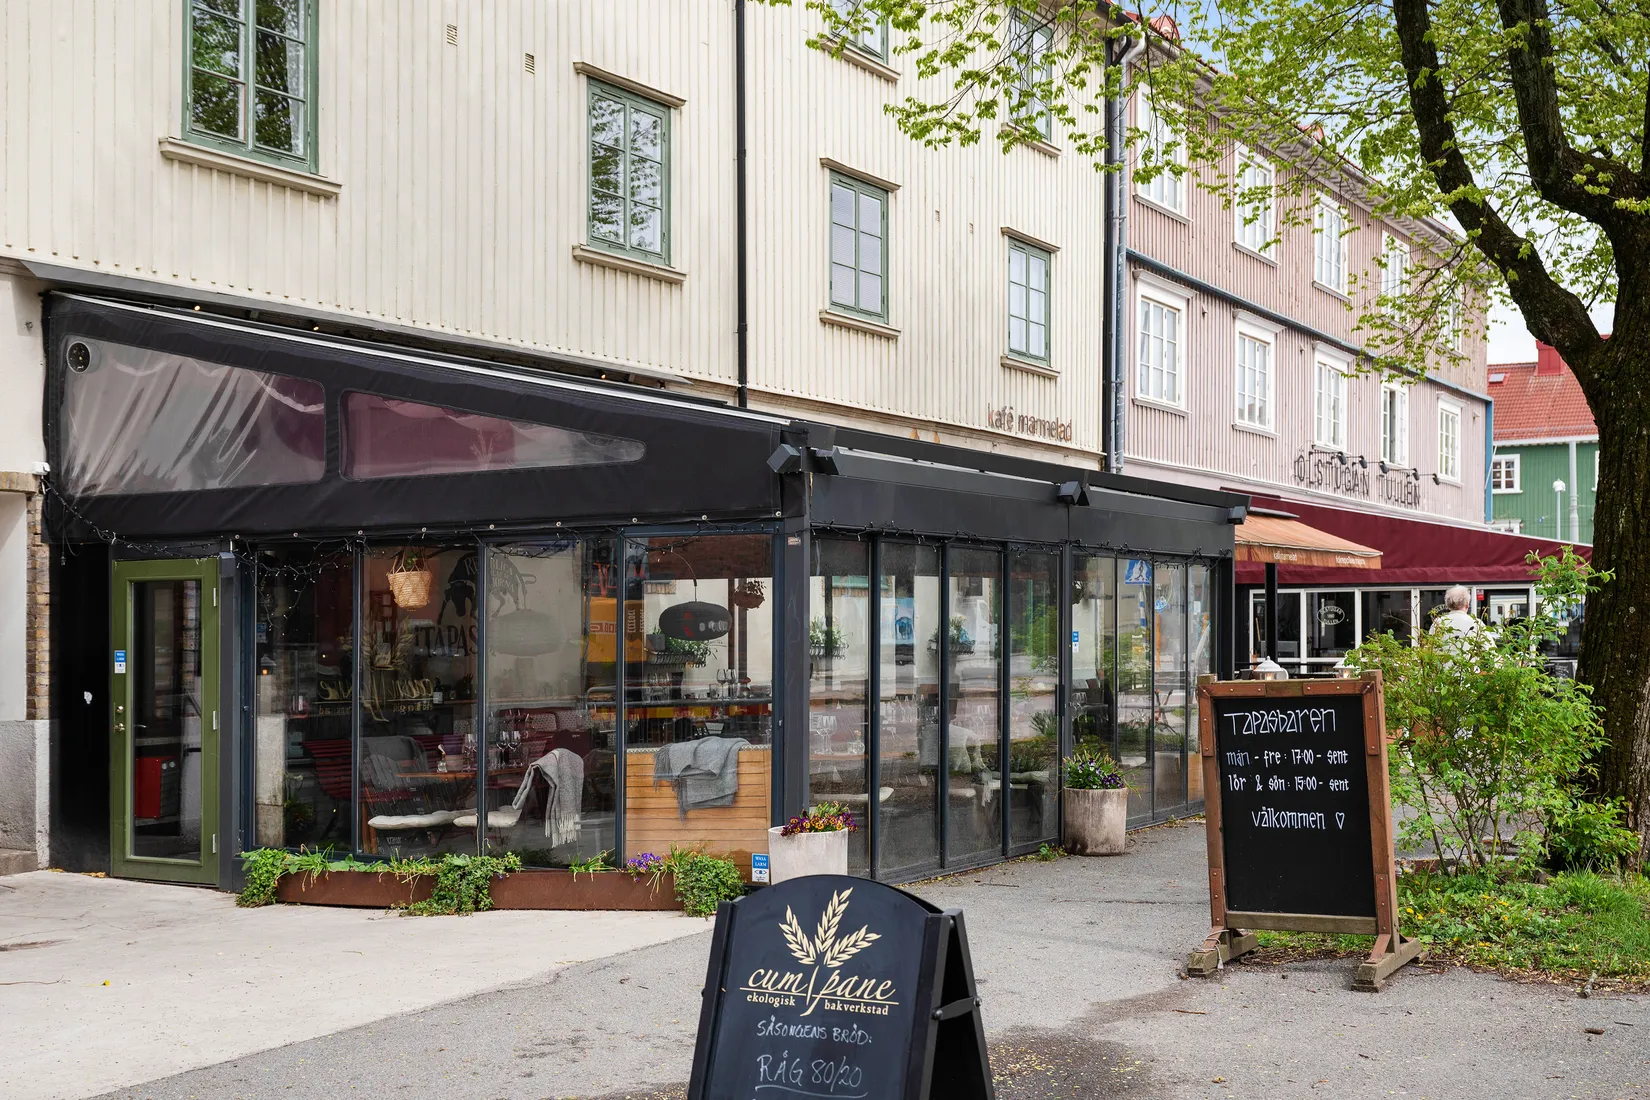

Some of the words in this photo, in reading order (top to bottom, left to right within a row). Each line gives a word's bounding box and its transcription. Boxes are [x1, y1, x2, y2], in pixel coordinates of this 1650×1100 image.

[987, 402, 1014, 432] kafé
[1327, 749, 1349, 765] sent
[1228, 774, 1247, 791] lör
[1255, 774, 1263, 791] &
[1329, 779, 1350, 792] sent
[1251, 806, 1326, 829] välkommen
[748, 967, 806, 994] cum
[746, 993, 796, 1008] ekologisk
[824, 999, 889, 1016] bakverkstad
[756, 1050, 804, 1086] RÅG
[811, 1056, 862, 1092] 80/20
